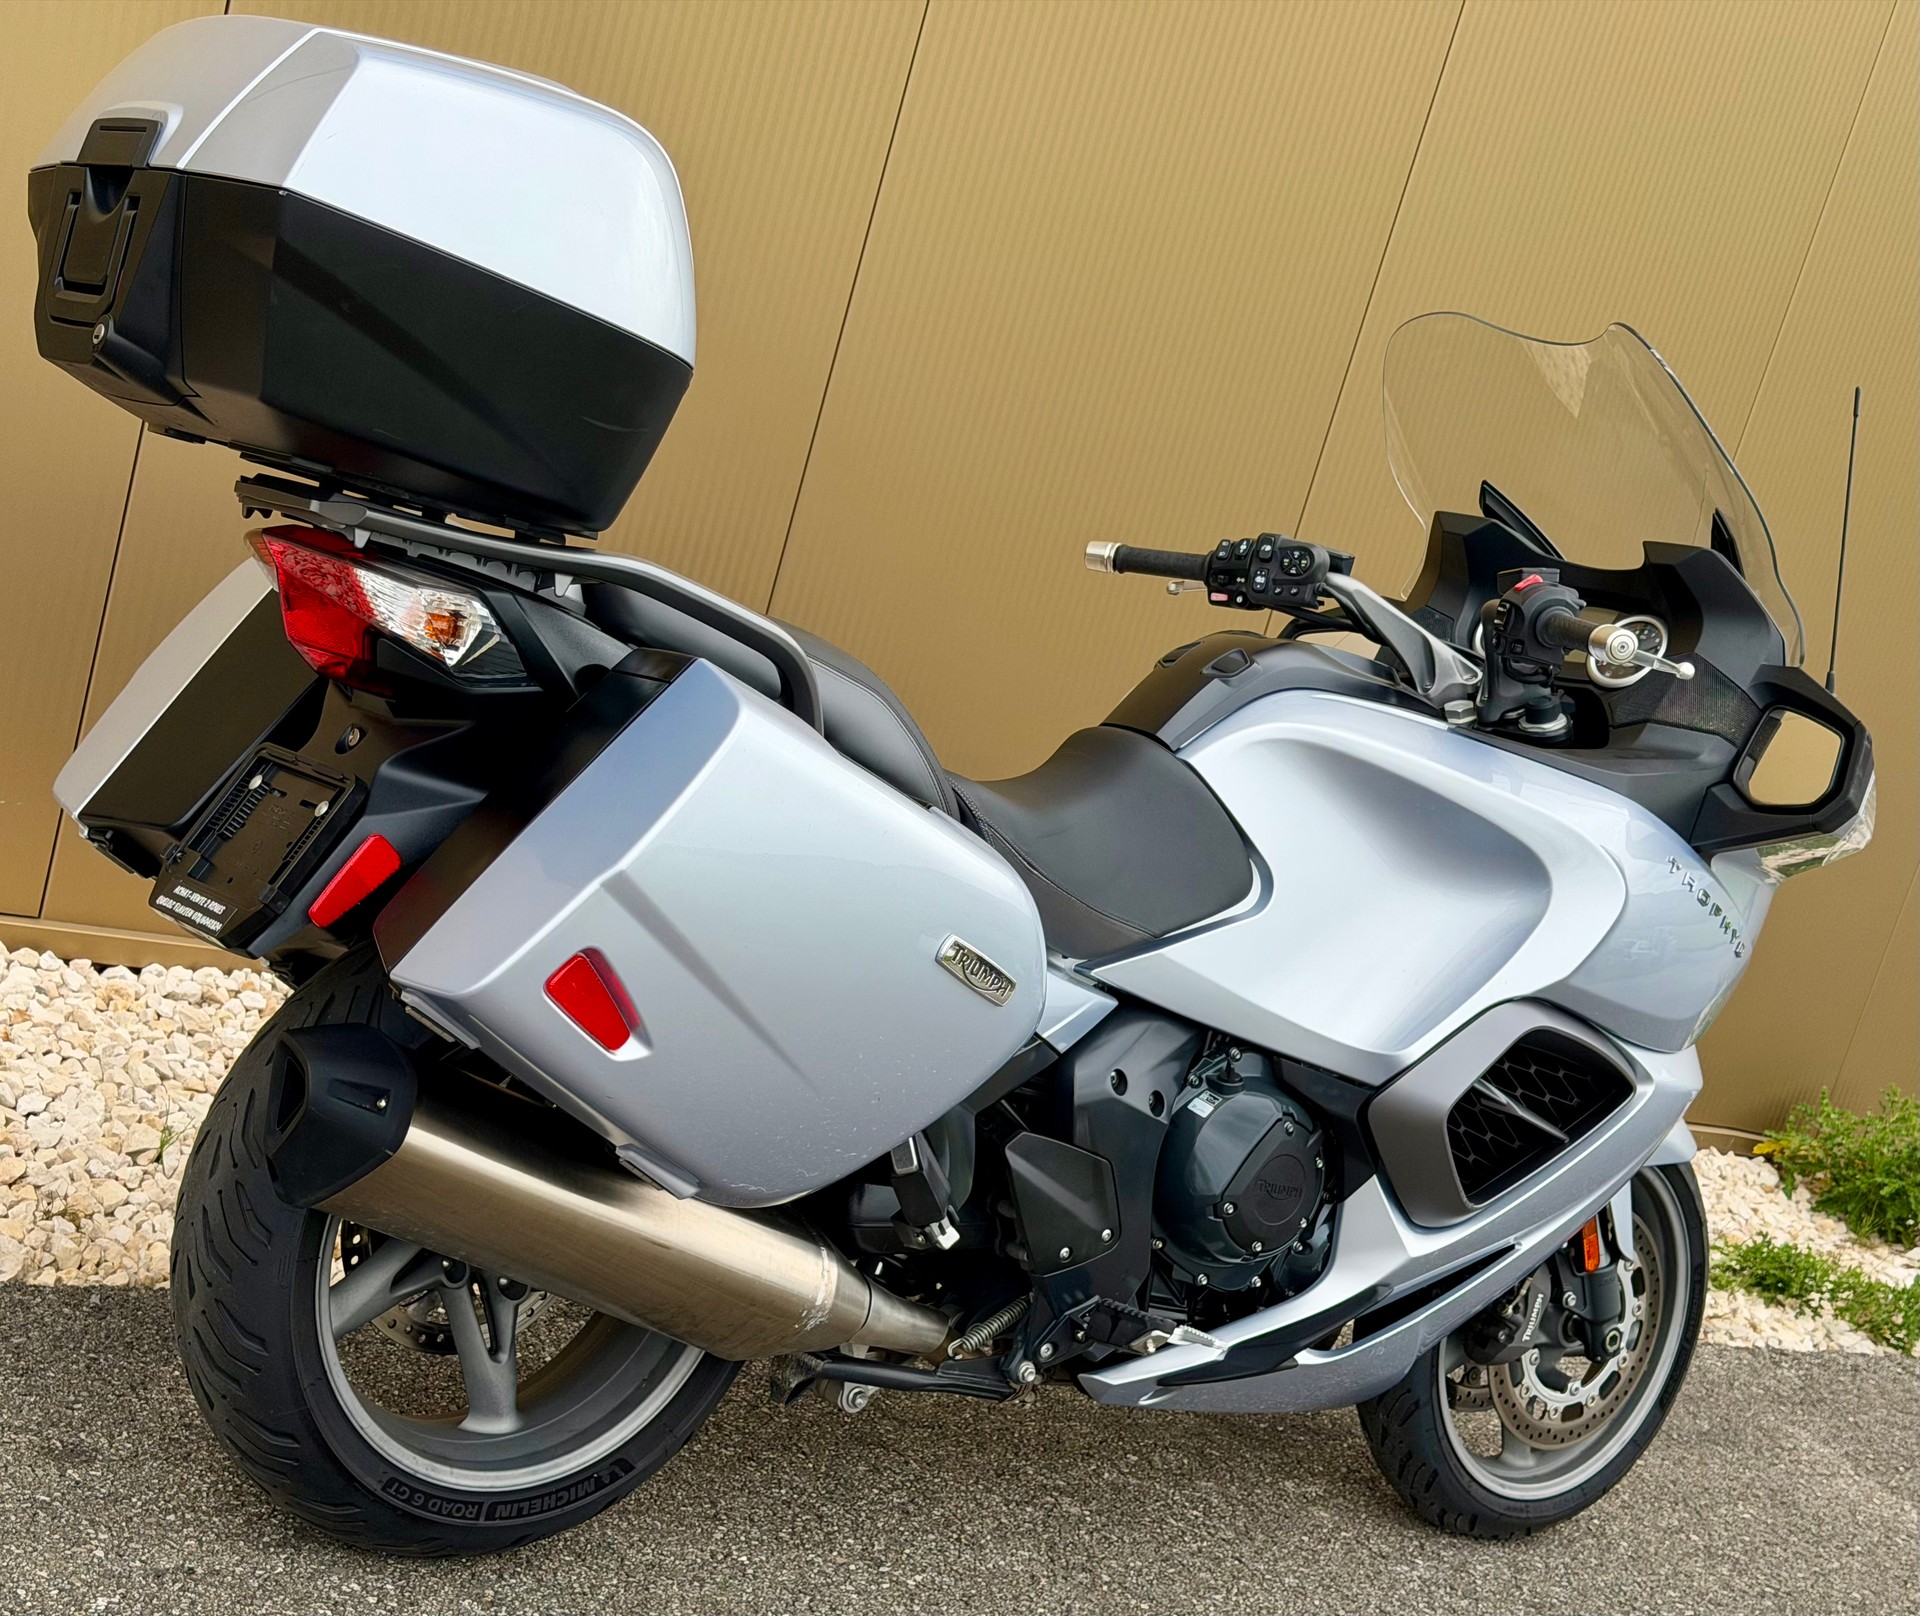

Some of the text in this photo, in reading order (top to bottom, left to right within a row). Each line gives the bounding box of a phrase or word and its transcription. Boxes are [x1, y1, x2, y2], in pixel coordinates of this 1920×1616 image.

[207, 900, 226, 915] ROUES
[950, 943, 1012, 998] TRIUMPH
[1257, 1179, 1303, 1199] TRIUMPH
[1521, 1293, 1544, 1342] TRIUMPH
[387, 1480, 597, 1519] MICHELIN ROAD 6 GT
